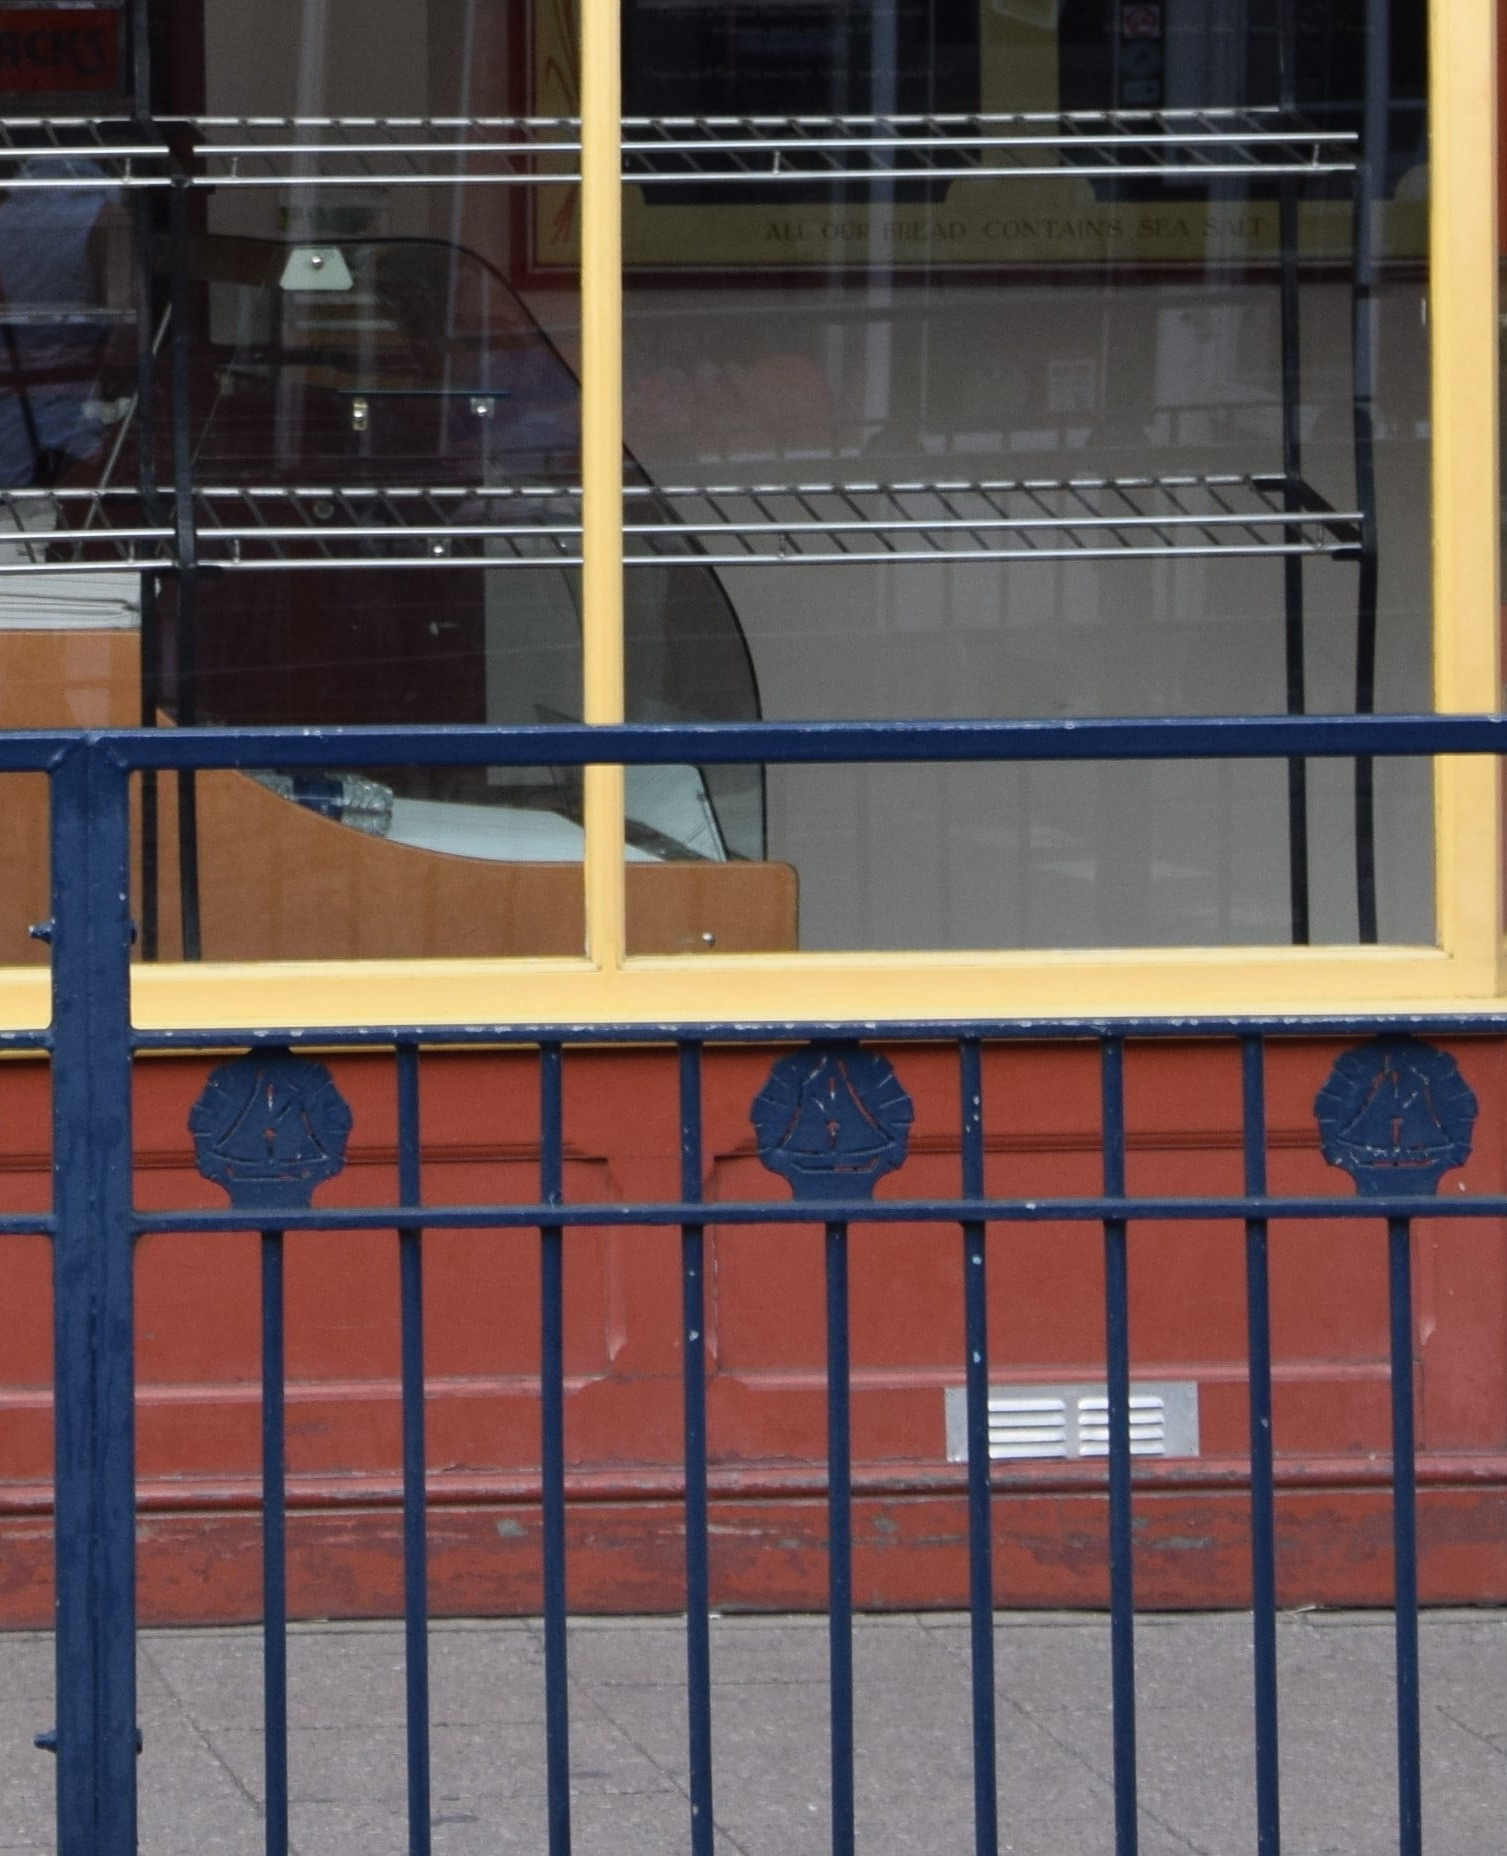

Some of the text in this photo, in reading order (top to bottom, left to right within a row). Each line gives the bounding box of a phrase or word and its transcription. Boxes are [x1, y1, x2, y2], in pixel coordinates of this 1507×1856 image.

[764, 217, 1267, 243] ALL OUR BREAD CONTAINS SEA SALT
